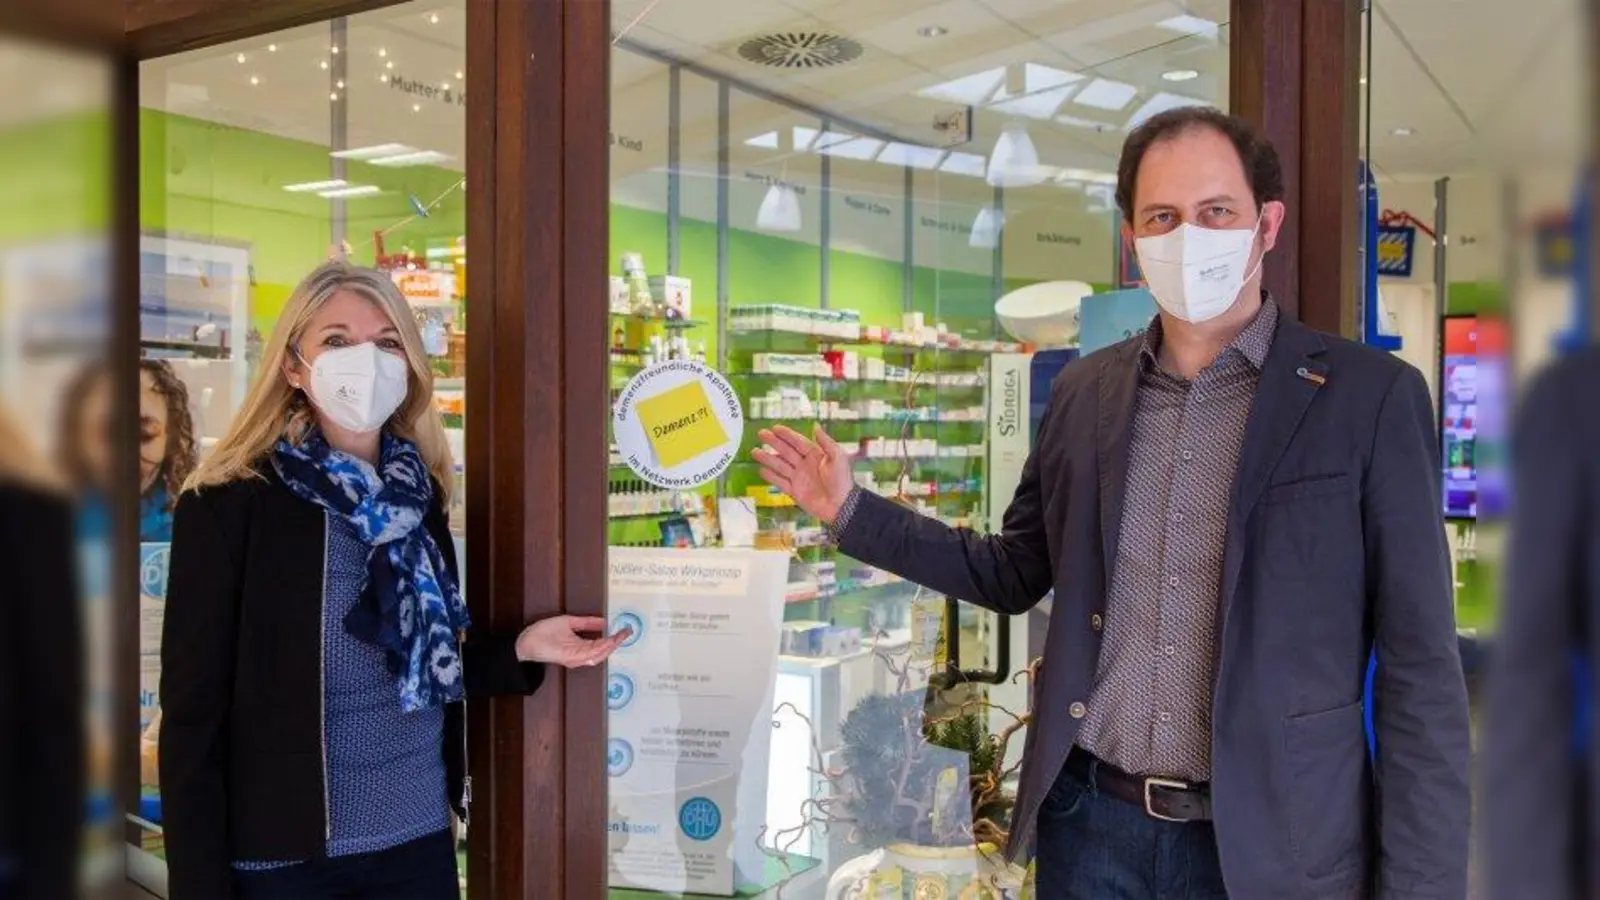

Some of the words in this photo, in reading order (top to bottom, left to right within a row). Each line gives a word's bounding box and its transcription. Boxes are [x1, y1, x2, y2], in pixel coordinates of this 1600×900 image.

[390, 74, 439, 100] Mutter
[618, 361, 704, 421] demenzfreundliche
[705, 372, 740, 419] Apotheke
[640, 467, 692, 486] Netzwerk
[693, 451, 733, 484] Demenz
